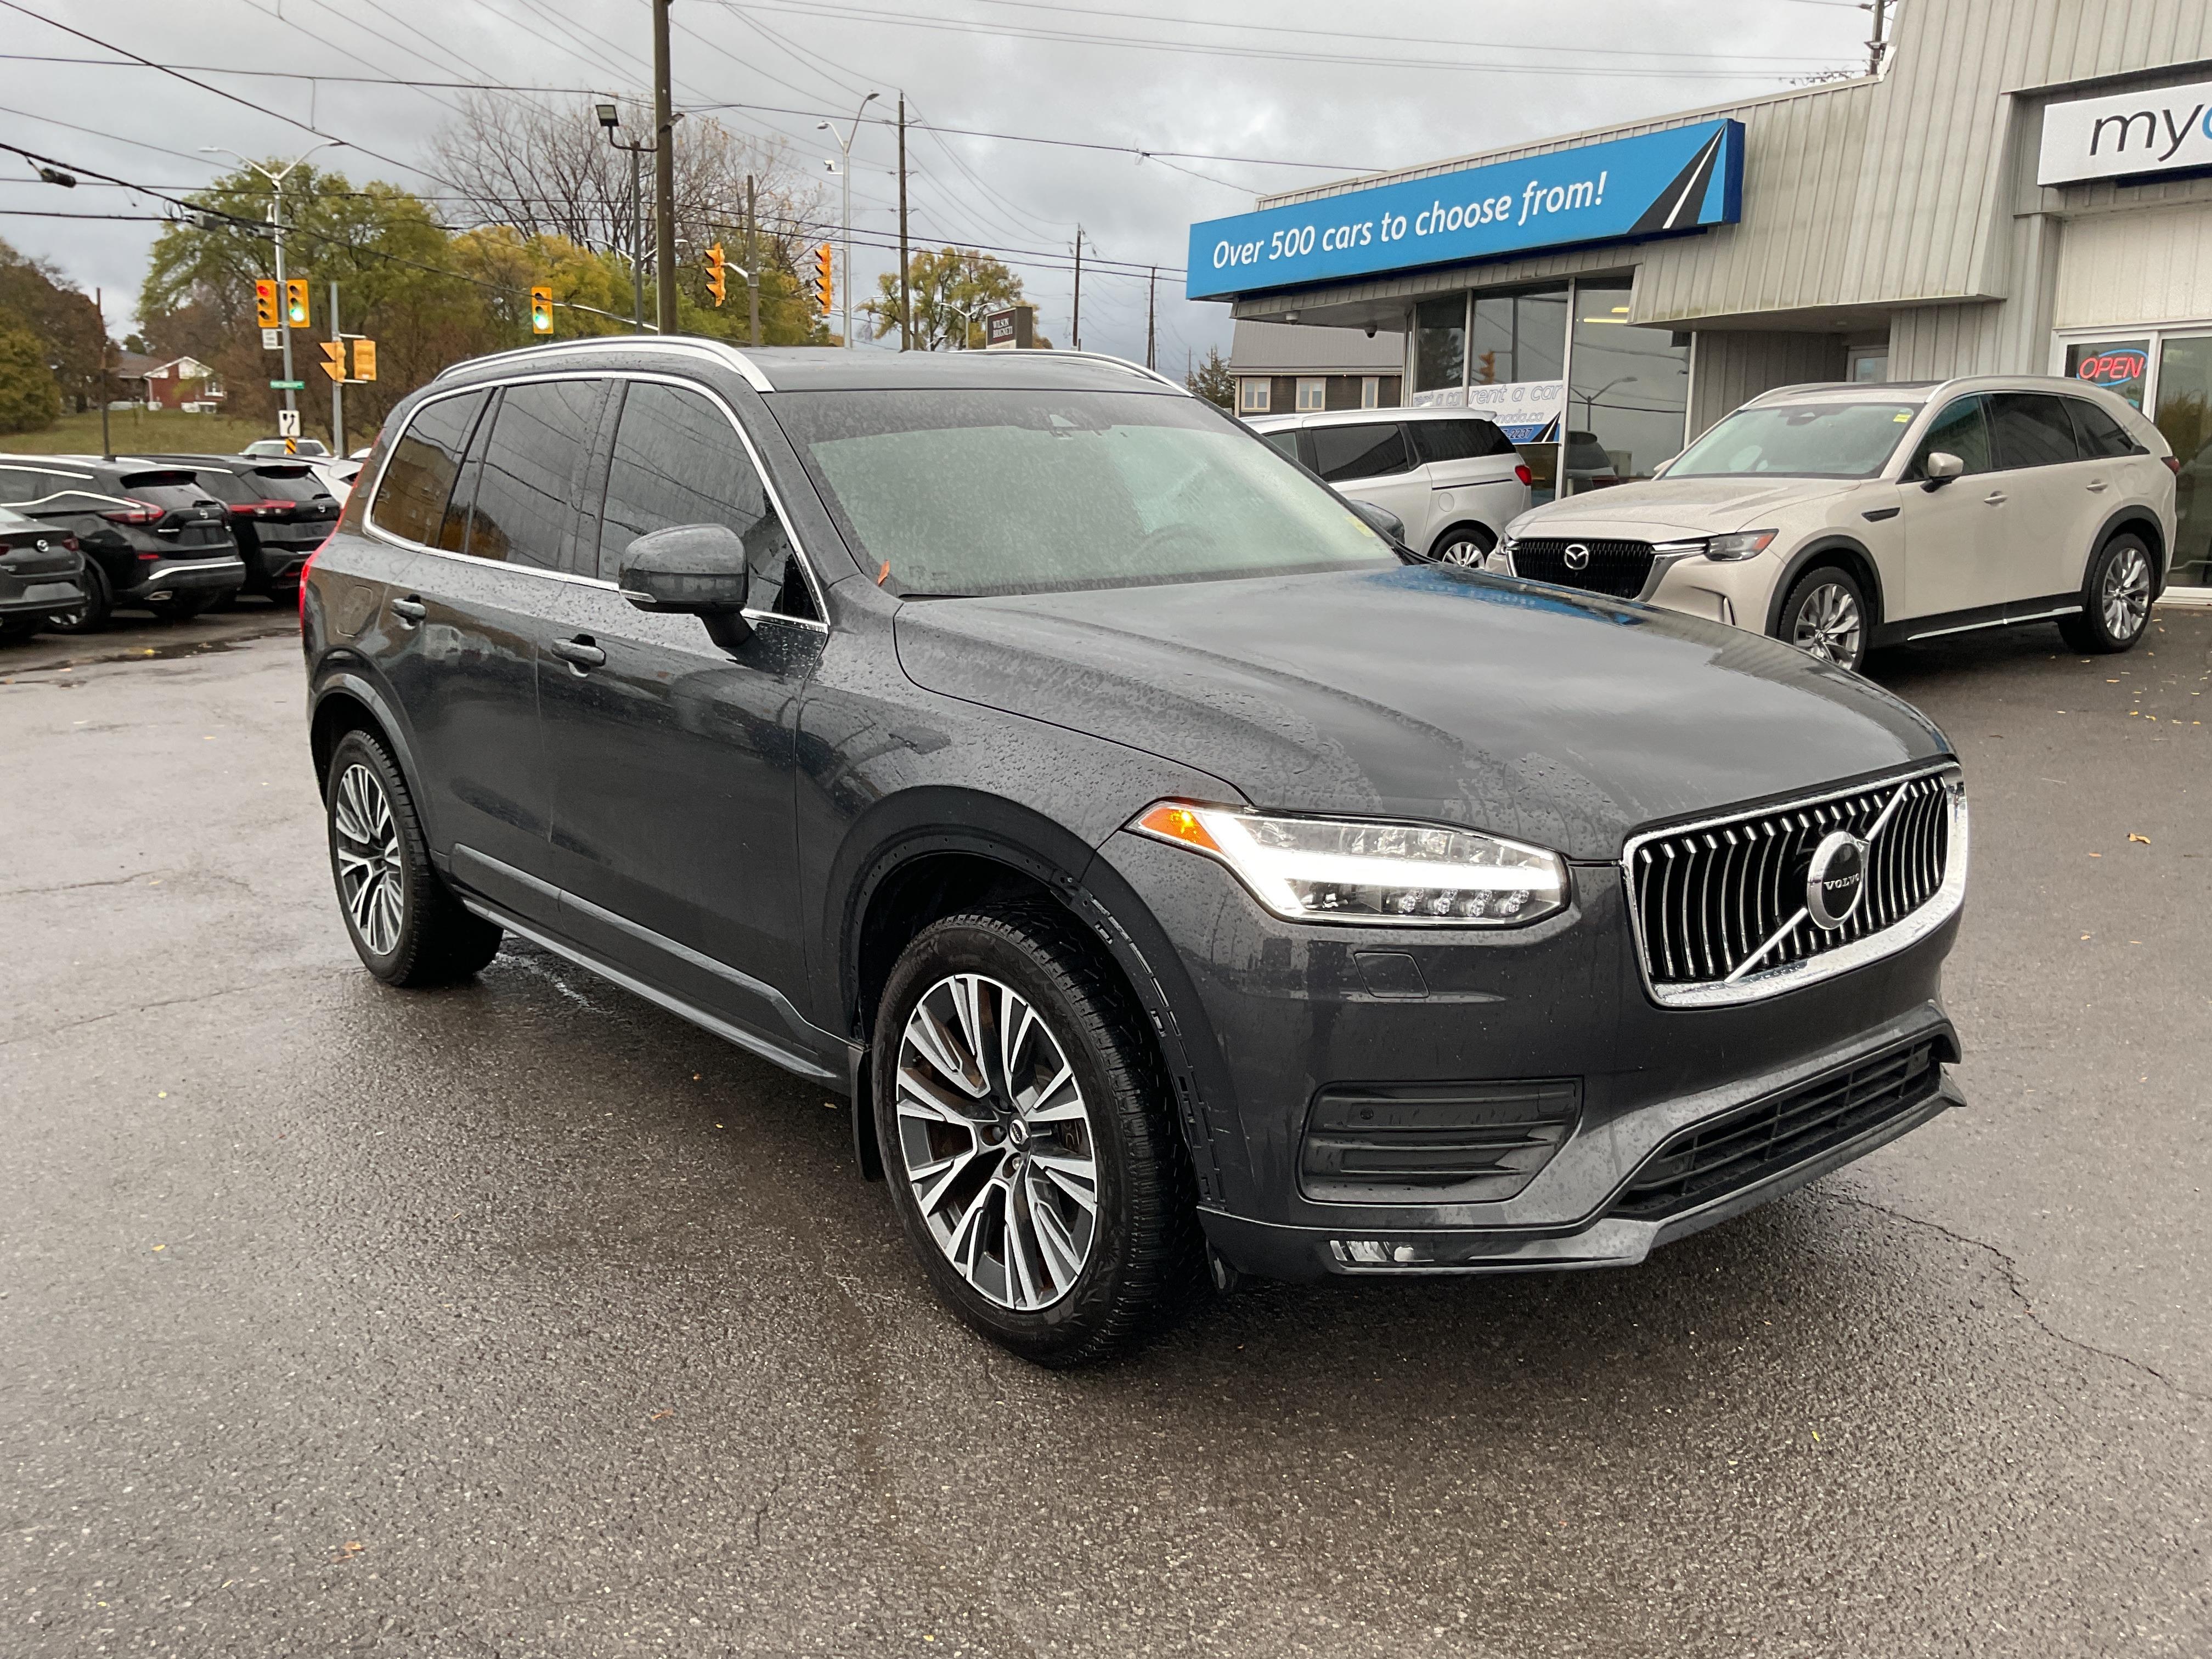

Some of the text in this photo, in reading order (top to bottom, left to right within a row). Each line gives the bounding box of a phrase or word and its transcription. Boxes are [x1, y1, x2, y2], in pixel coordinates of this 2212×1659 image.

[2089, 104, 2212, 162] my
[1213, 171, 1608, 269] Over 500 cars to choose from!
[2079, 357, 2145, 379] OPEN
[1469, 385, 1562, 405] rent a car
[1495, 409, 1544, 424] nada.ca
[1502, 428, 1533, 439] 7-2237
[1823, 873, 1860, 891] VOLVO
